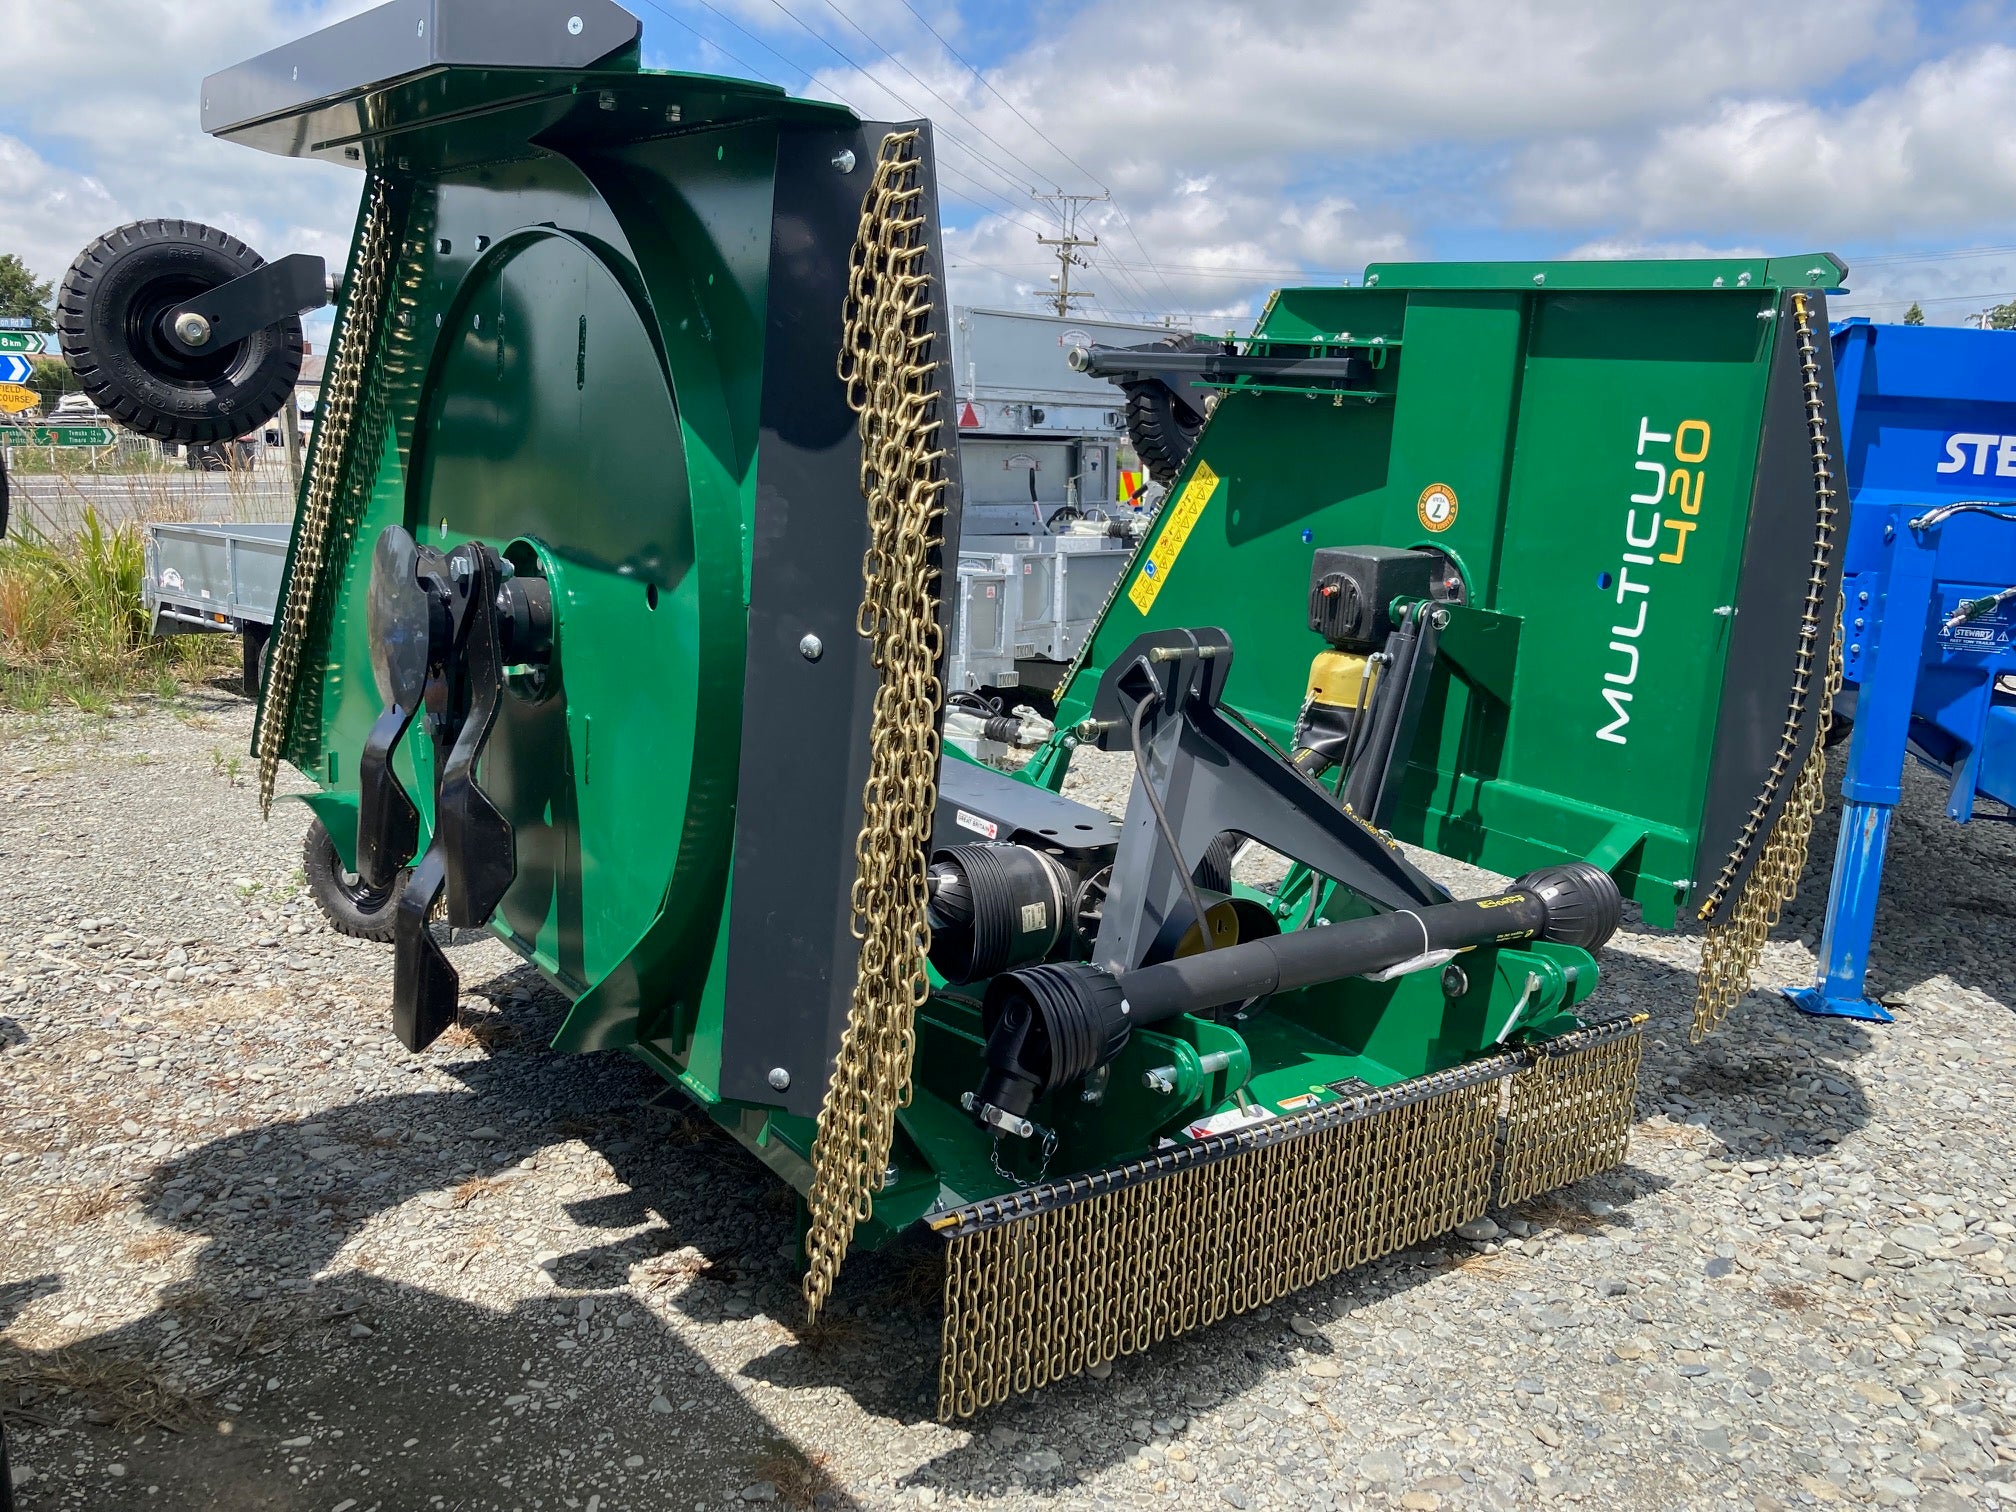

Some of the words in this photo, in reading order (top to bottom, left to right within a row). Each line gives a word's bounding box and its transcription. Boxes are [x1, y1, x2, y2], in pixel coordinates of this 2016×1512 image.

[2, 338, 8, 346] 8
[1658, 419, 1712, 565] 420
[1432, 503, 1441, 519] 7
[1595, 416, 1672, 745] MULTICUT
[1956, 629, 1991, 639] STEWART
[958, 813, 972, 826] GREAT
